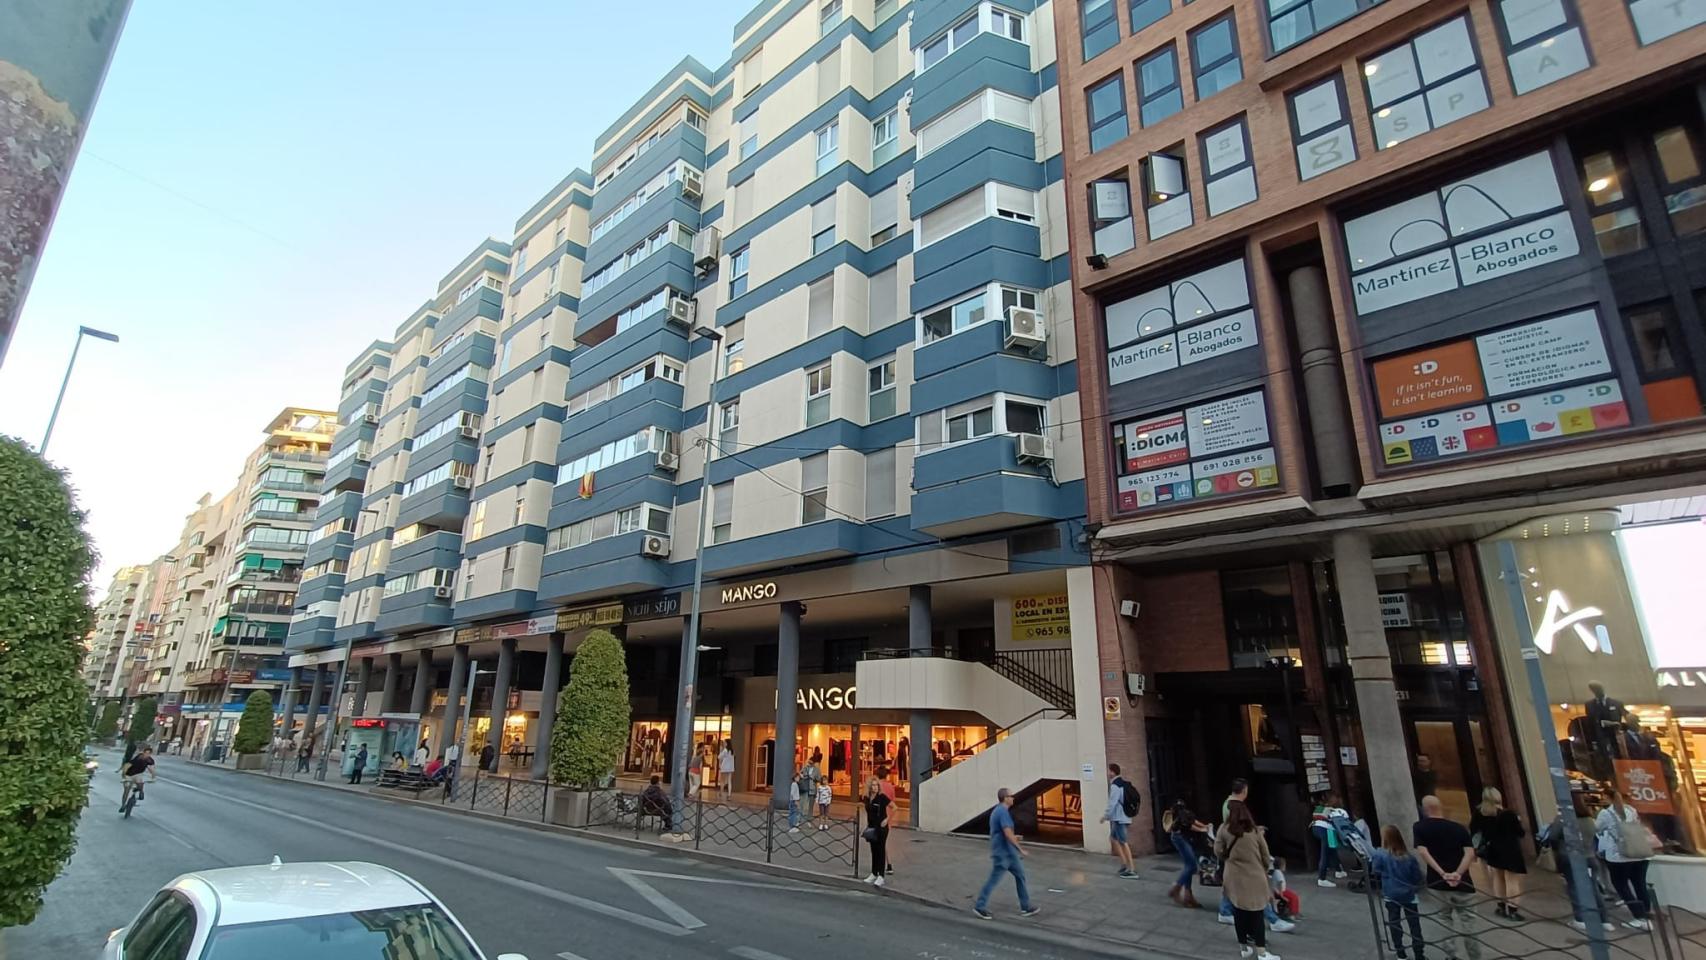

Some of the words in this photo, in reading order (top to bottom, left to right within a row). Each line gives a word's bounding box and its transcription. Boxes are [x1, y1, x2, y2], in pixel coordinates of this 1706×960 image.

[1475, 243, 1558, 274] Abogados
[1189, 336, 1243, 356] Abogados
[1428, 384, 1472, 399] learning
[1222, 459, 1240, 467] 028
[1128, 478, 1143, 486] 965
[722, 582, 776, 604] MANGO
[1015, 598, 1036, 610] 600
[1036, 628, 1054, 636] 965
[775, 686, 856, 710] ANGO
